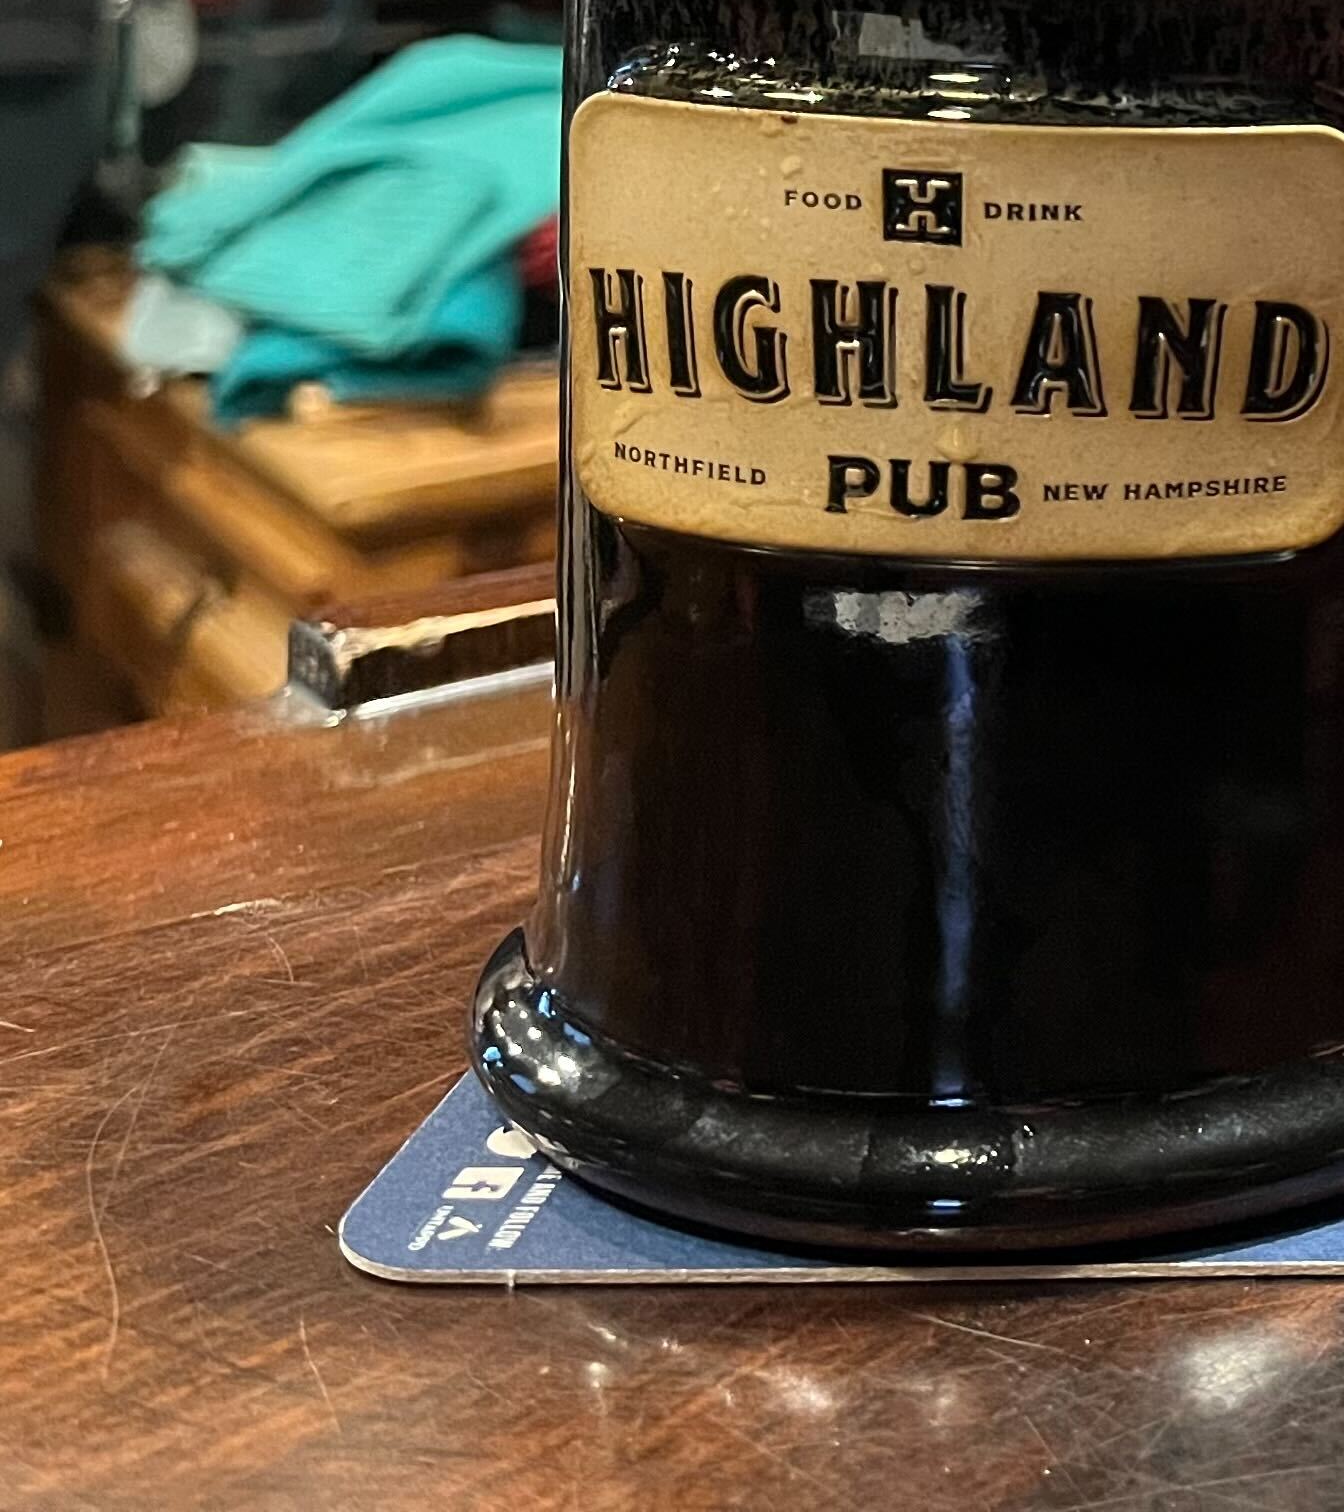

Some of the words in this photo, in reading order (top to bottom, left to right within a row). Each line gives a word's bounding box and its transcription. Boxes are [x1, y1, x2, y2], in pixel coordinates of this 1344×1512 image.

[784, 189, 863, 211] FOOD
[983, 201, 1083, 222] DRINK
[588, 267, 1331, 423] HIGHLAND
[613, 441, 767, 487] NORTHFIELD
[823, 454, 1022, 521] PUB
[1042, 482, 1110, 502] NEW
[1123, 474, 1288, 501] HAMPSHIRE
[520, 1183, 556, 1204] AND
